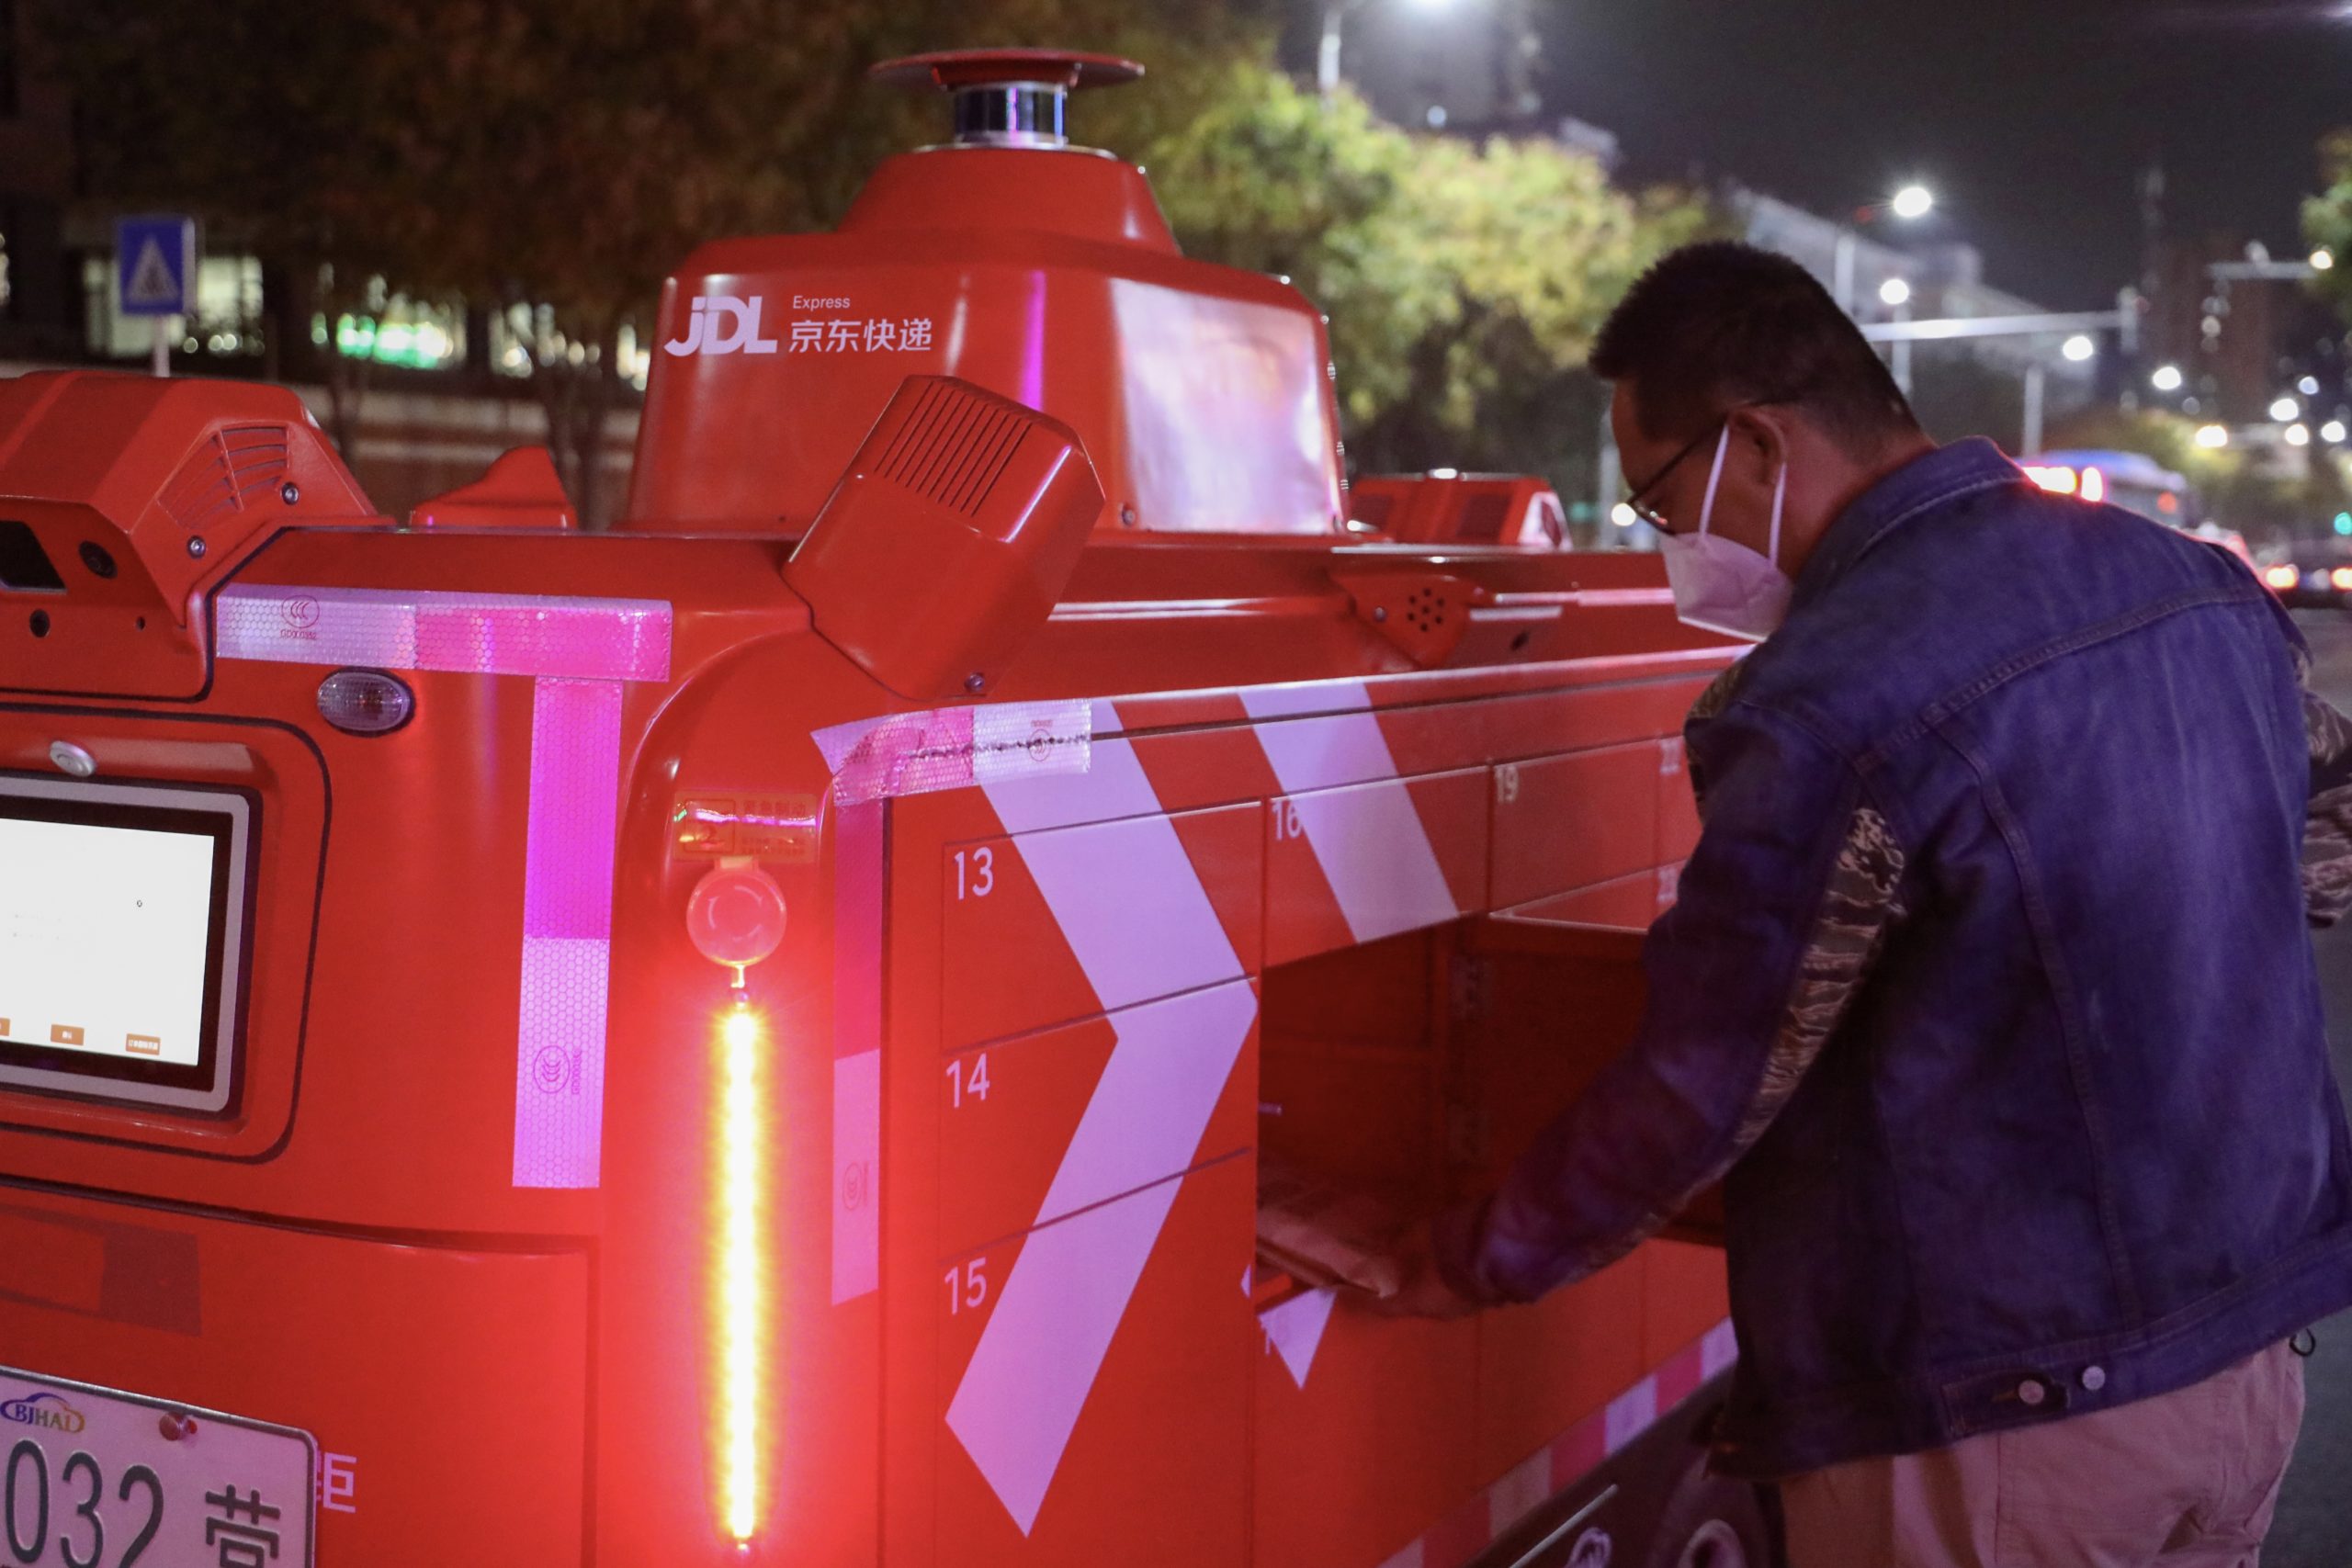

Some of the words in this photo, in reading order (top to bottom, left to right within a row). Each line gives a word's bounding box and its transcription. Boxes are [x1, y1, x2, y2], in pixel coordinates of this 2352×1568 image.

[792, 295, 851, 312] Express
[788, 317, 933, 353] 京东快递
[1494, 765, 1520, 804] 19
[1272, 801, 1301, 841] 16
[954, 847, 993, 901] 13
[945, 1053, 990, 1109] 14
[944, 1257, 988, 1315] 15
[6, 1438, 164, 1568] 032
